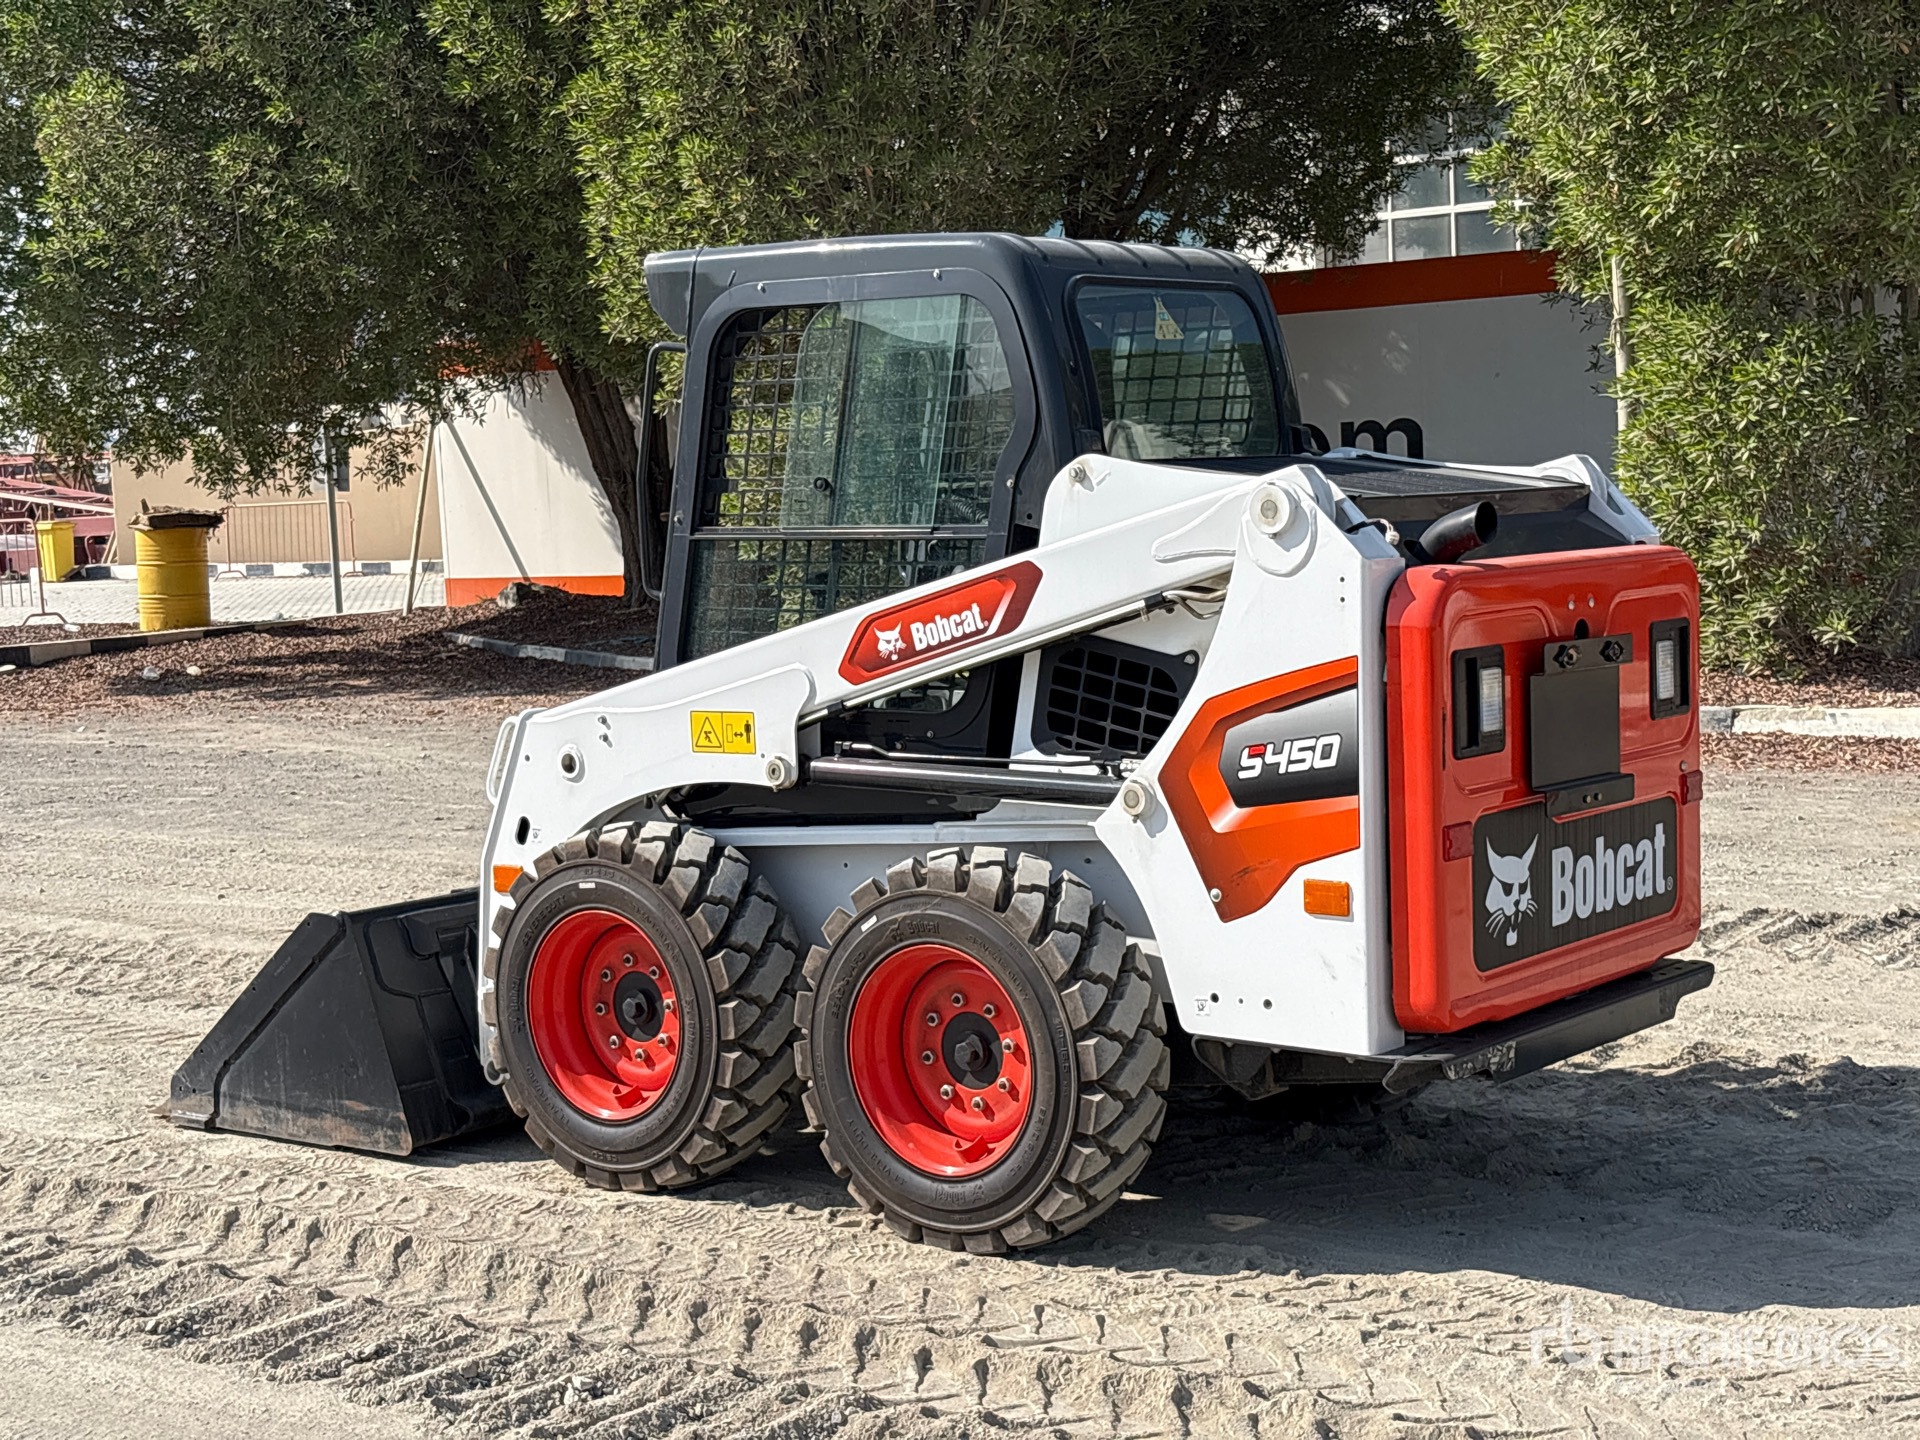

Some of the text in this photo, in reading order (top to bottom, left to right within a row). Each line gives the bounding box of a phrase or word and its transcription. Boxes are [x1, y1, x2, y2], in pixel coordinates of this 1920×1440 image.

[910, 602, 985, 651] Bobcat
[1237, 733, 1342, 780] S450
[1551, 822, 1666, 927] Bobcat
